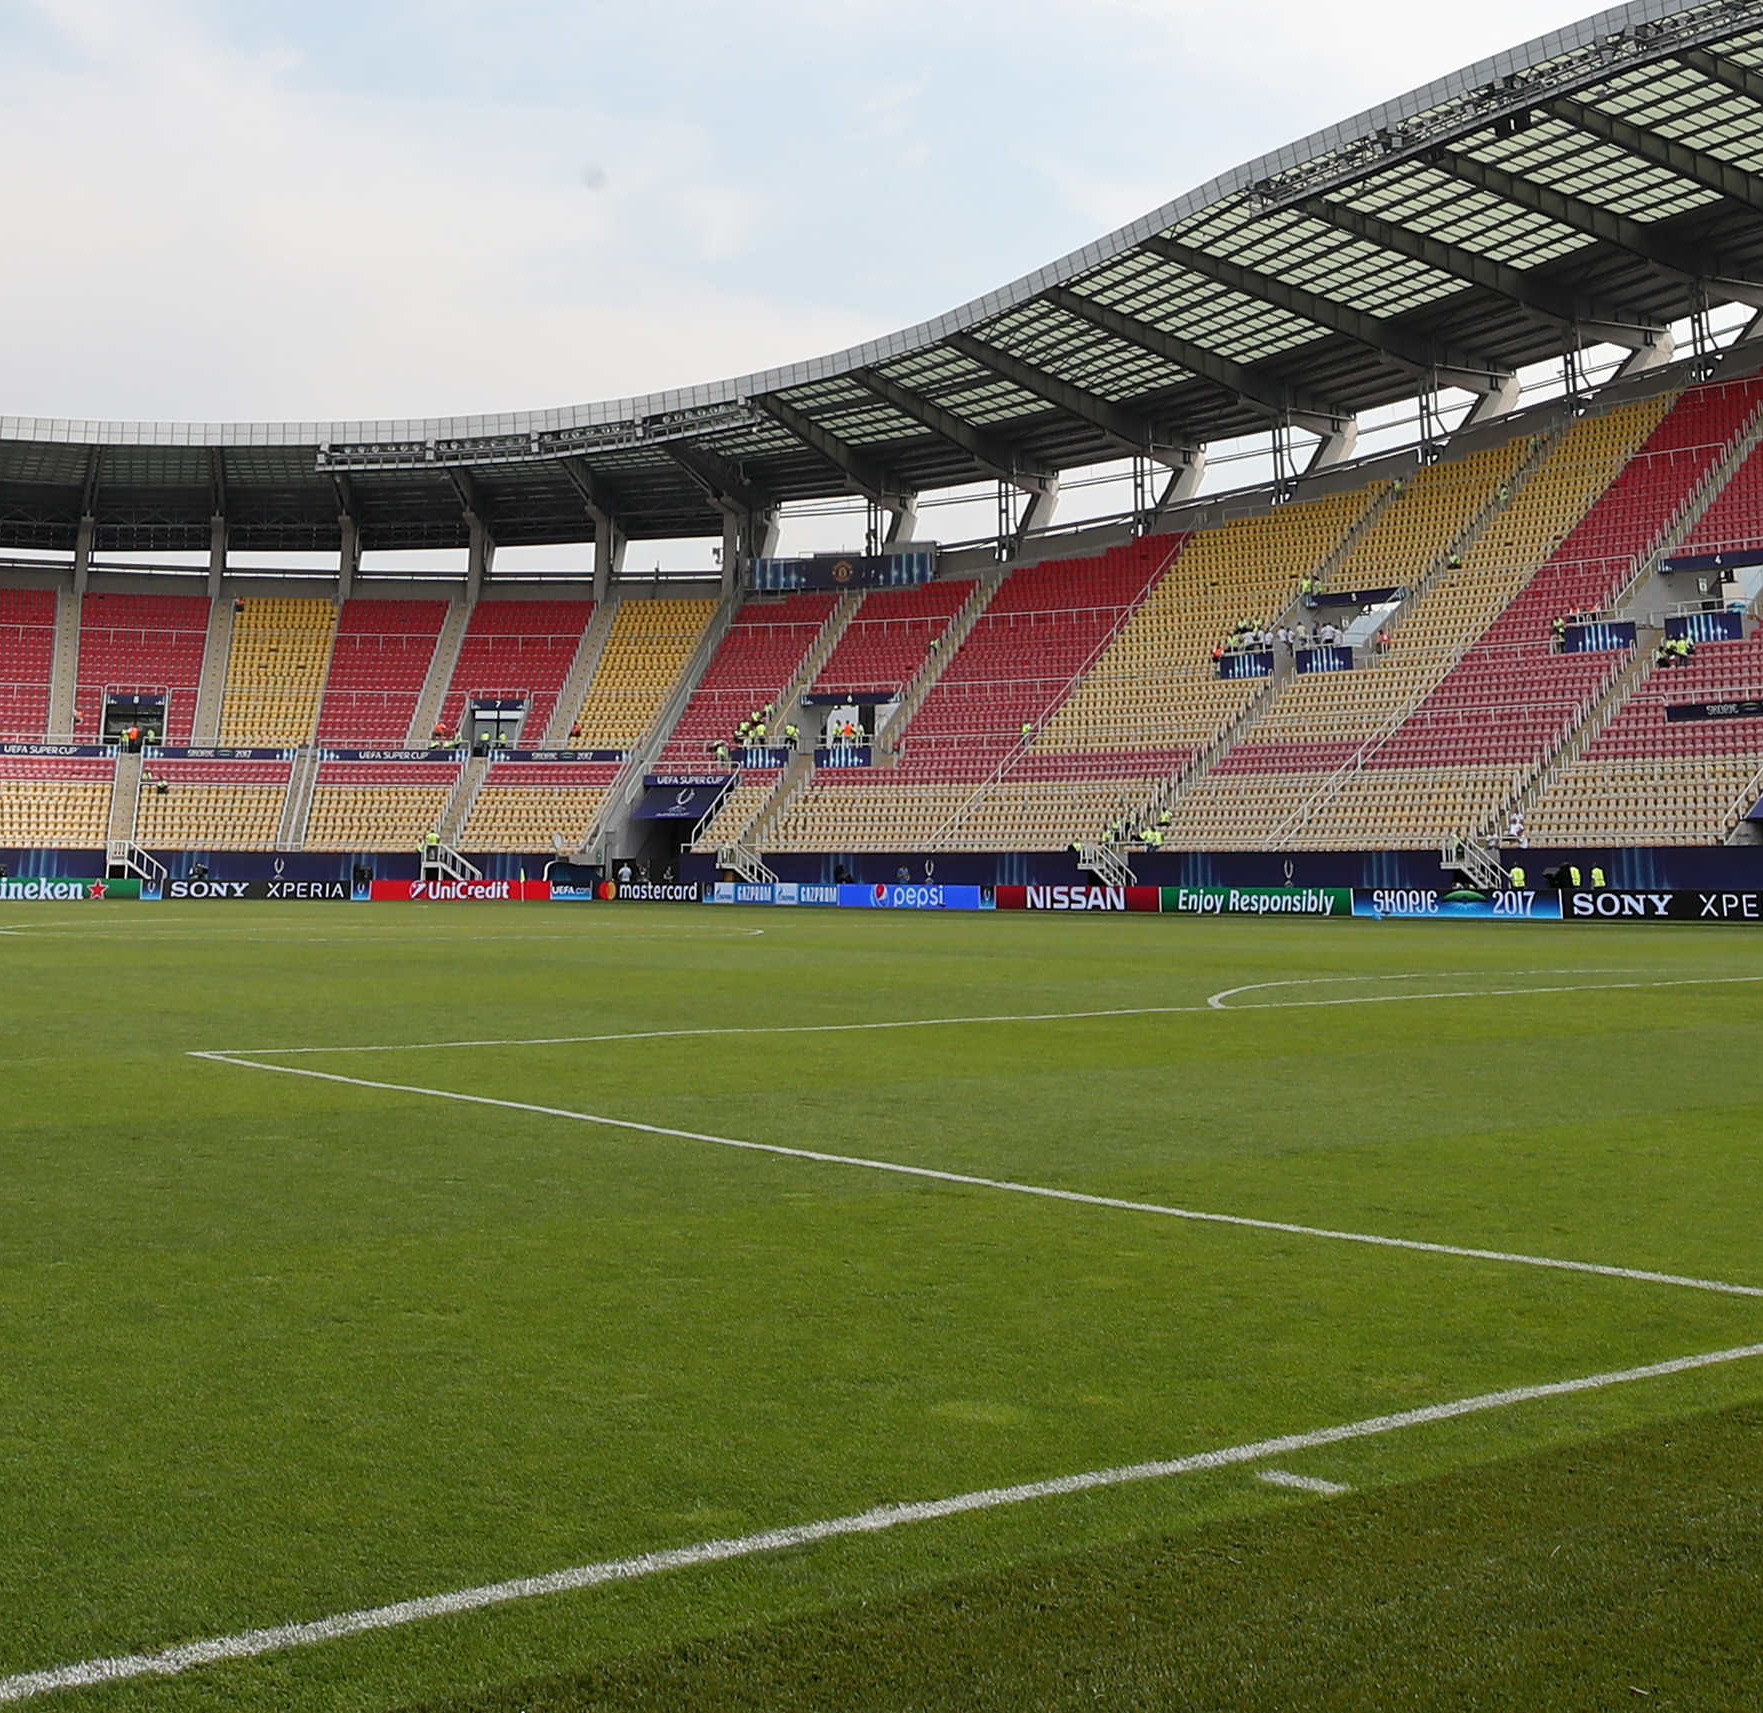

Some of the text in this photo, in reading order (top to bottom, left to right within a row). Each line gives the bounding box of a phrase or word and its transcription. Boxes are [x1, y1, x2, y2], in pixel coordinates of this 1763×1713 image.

[495, 699, 502, 709] 7
[1706, 702, 1739, 716] SKOPJE
[4, 745, 78, 755] UEFA SUPER CUP
[235, 749, 253, 759] 2017
[358, 750, 430, 760] UEFA SUPER CUP
[576, 751, 594, 761] 2017
[656, 775, 726, 785] UEFA SUPER CUP
[170, 881, 345, 898] SONY XPERIA
[428, 880, 510, 900] UniCredit
[551, 885, 592, 895] UEFA.com
[619, 882, 698, 901] mastercard
[737, 885, 772, 902] GAZPROM
[800, 885, 837, 902] GAZPROM
[894, 884, 945, 908] pepsi
[1026, 886, 1126, 910] NISSAN
[1178, 889, 1335, 916] Enjoy Responsibly
[1373, 890, 1536, 917] SKOPJE 2017
[1572, 893, 1674, 916] SONY
